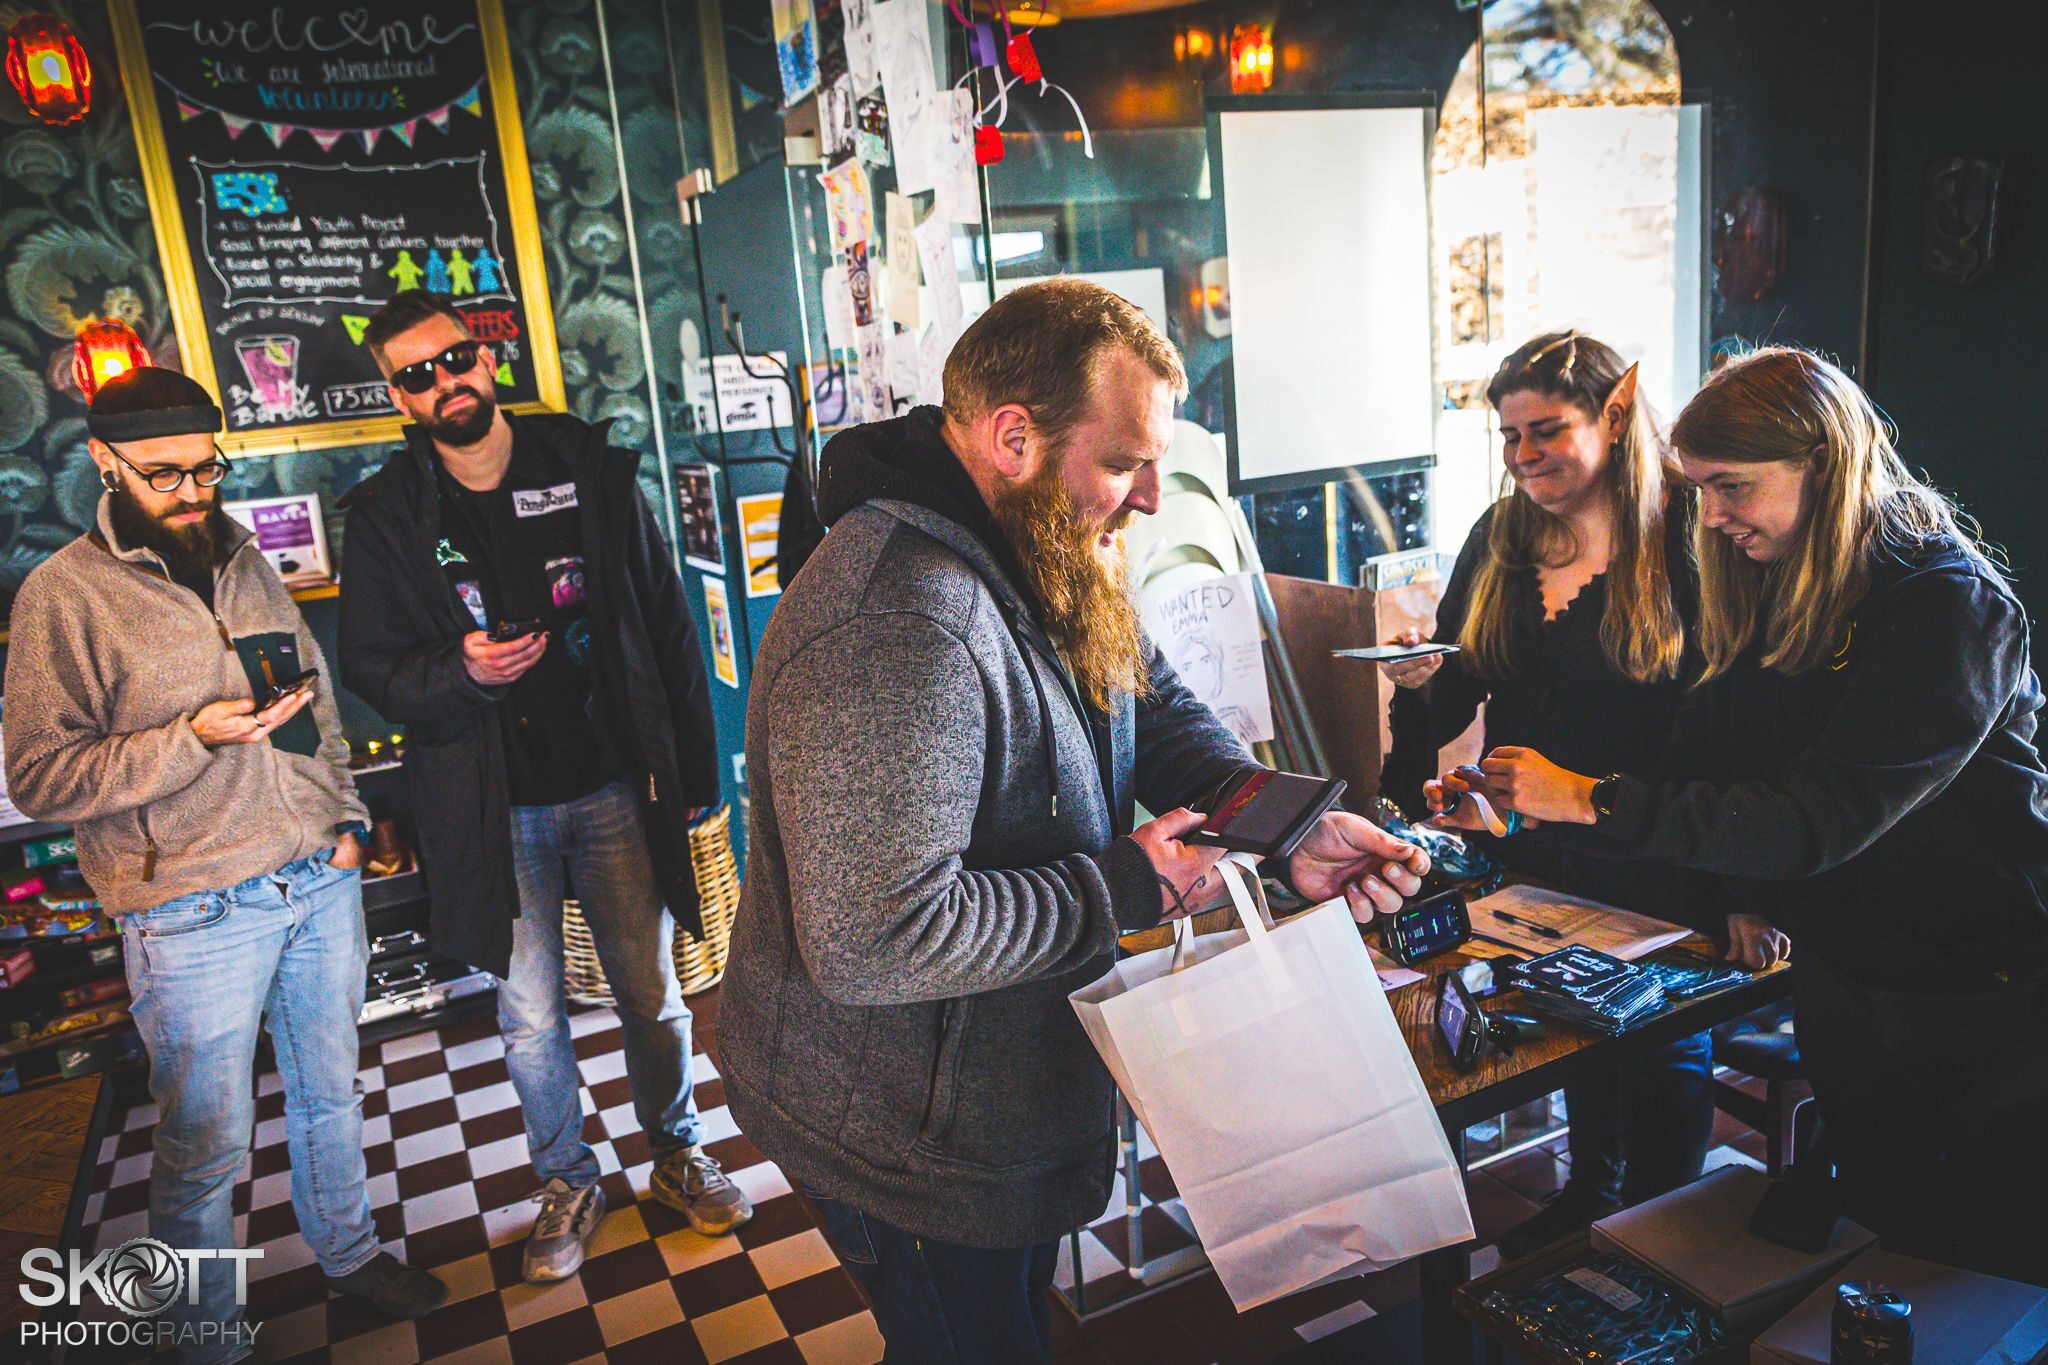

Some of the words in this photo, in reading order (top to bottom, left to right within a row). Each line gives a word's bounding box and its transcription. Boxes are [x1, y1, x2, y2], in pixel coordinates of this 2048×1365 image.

[274, 257, 295, 270] on
[1158, 585, 1235, 623] WANTED
[1172, 610, 1209, 636] EMMA
